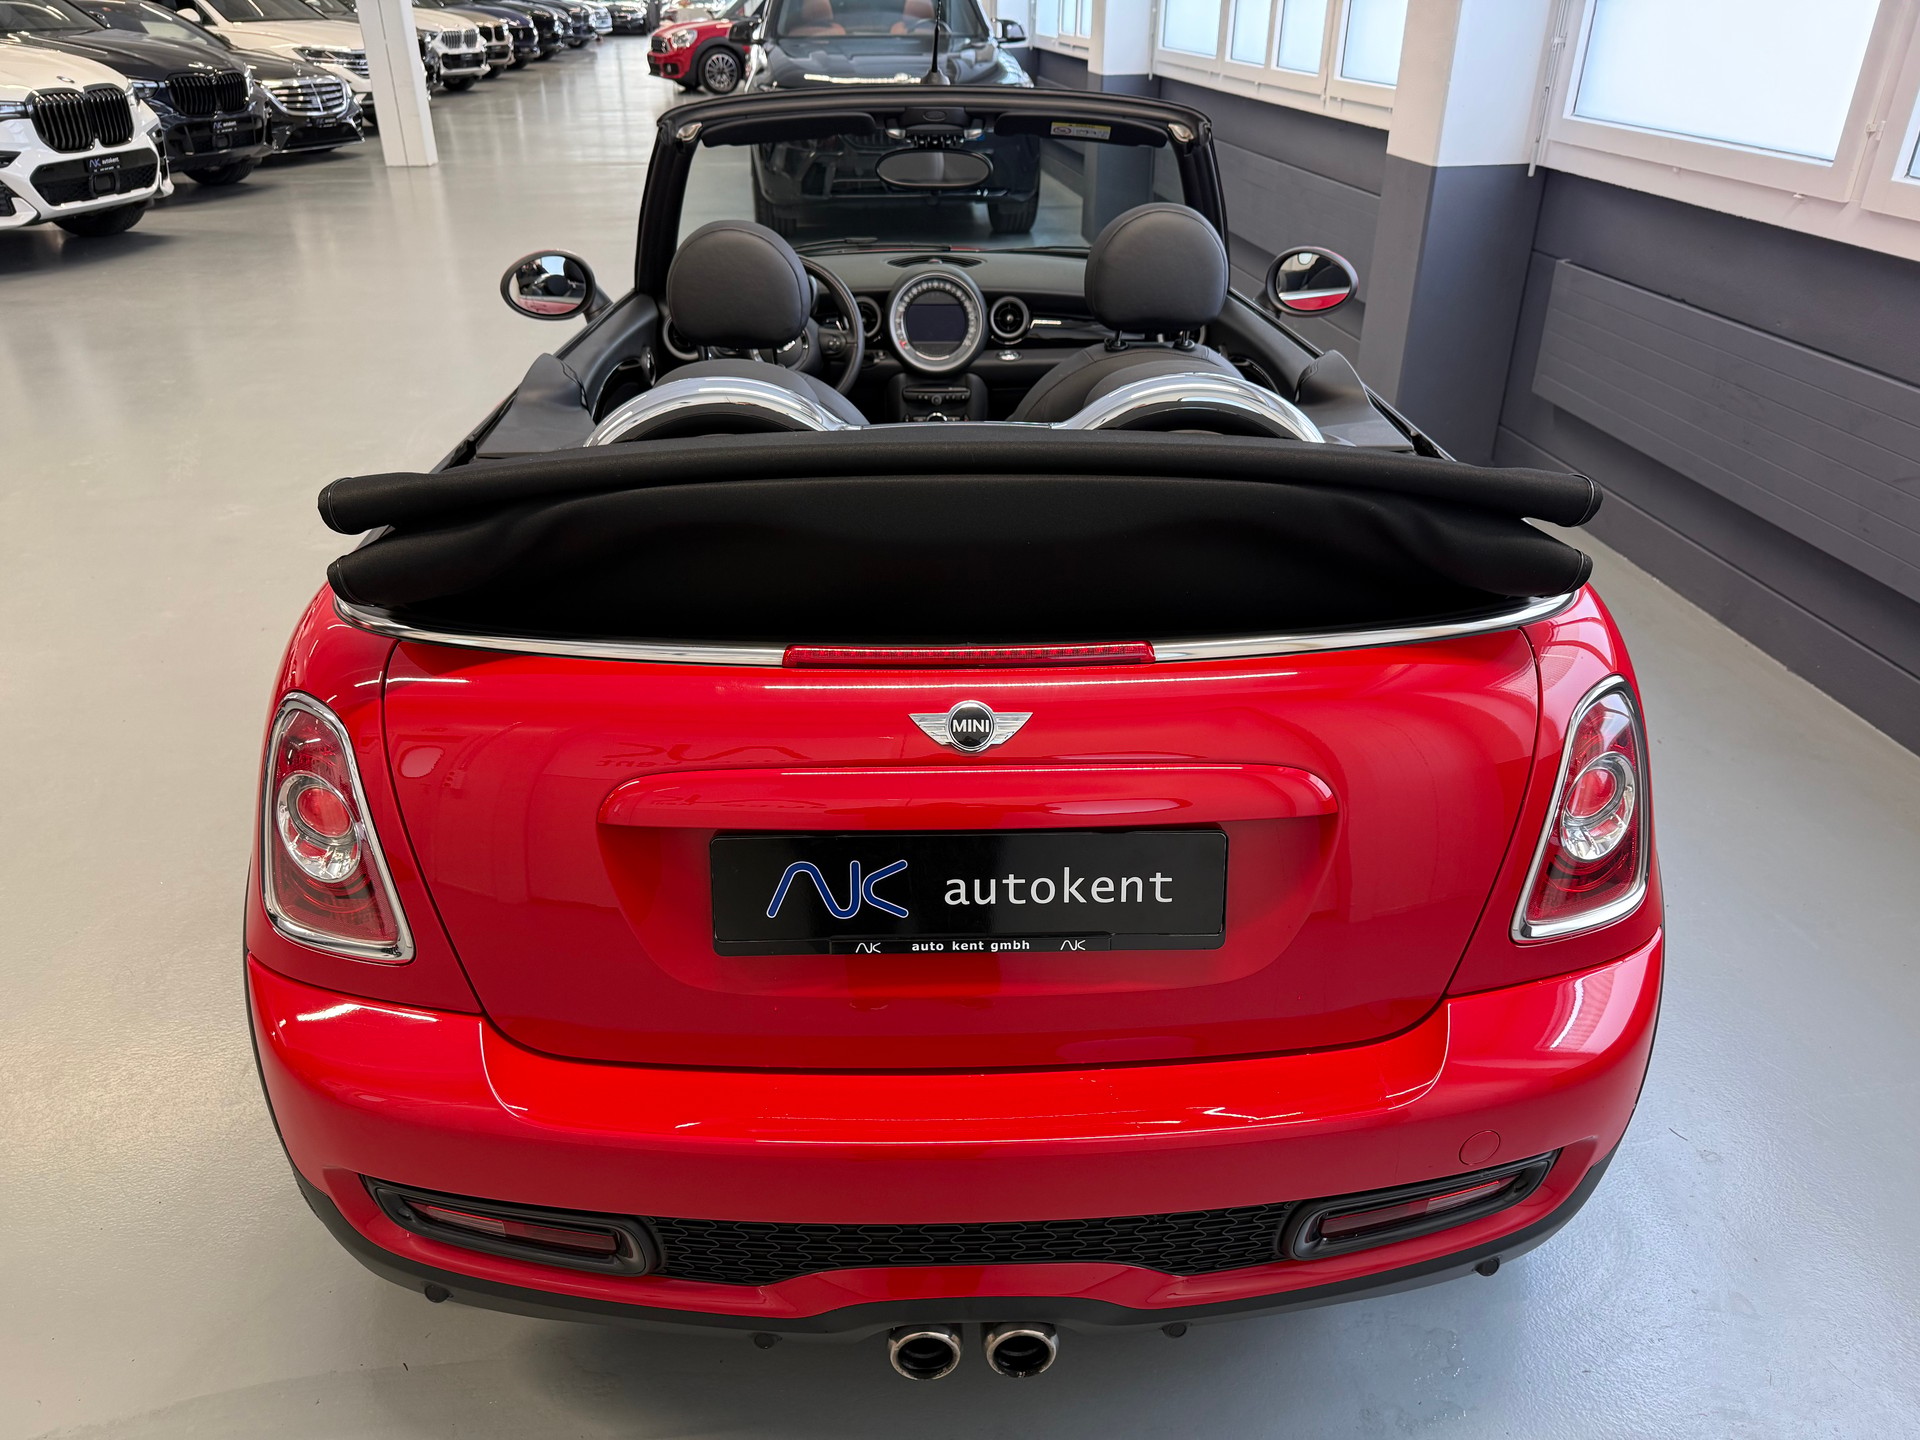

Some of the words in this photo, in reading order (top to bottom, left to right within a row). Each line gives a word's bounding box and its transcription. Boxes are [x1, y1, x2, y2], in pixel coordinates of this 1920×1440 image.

[952, 719, 989, 732] MINI
[944, 866, 1173, 905] autokent
[912, 942, 944, 951] auto
[952, 941, 984, 951] kent
[990, 940, 1030, 952] gmbh
